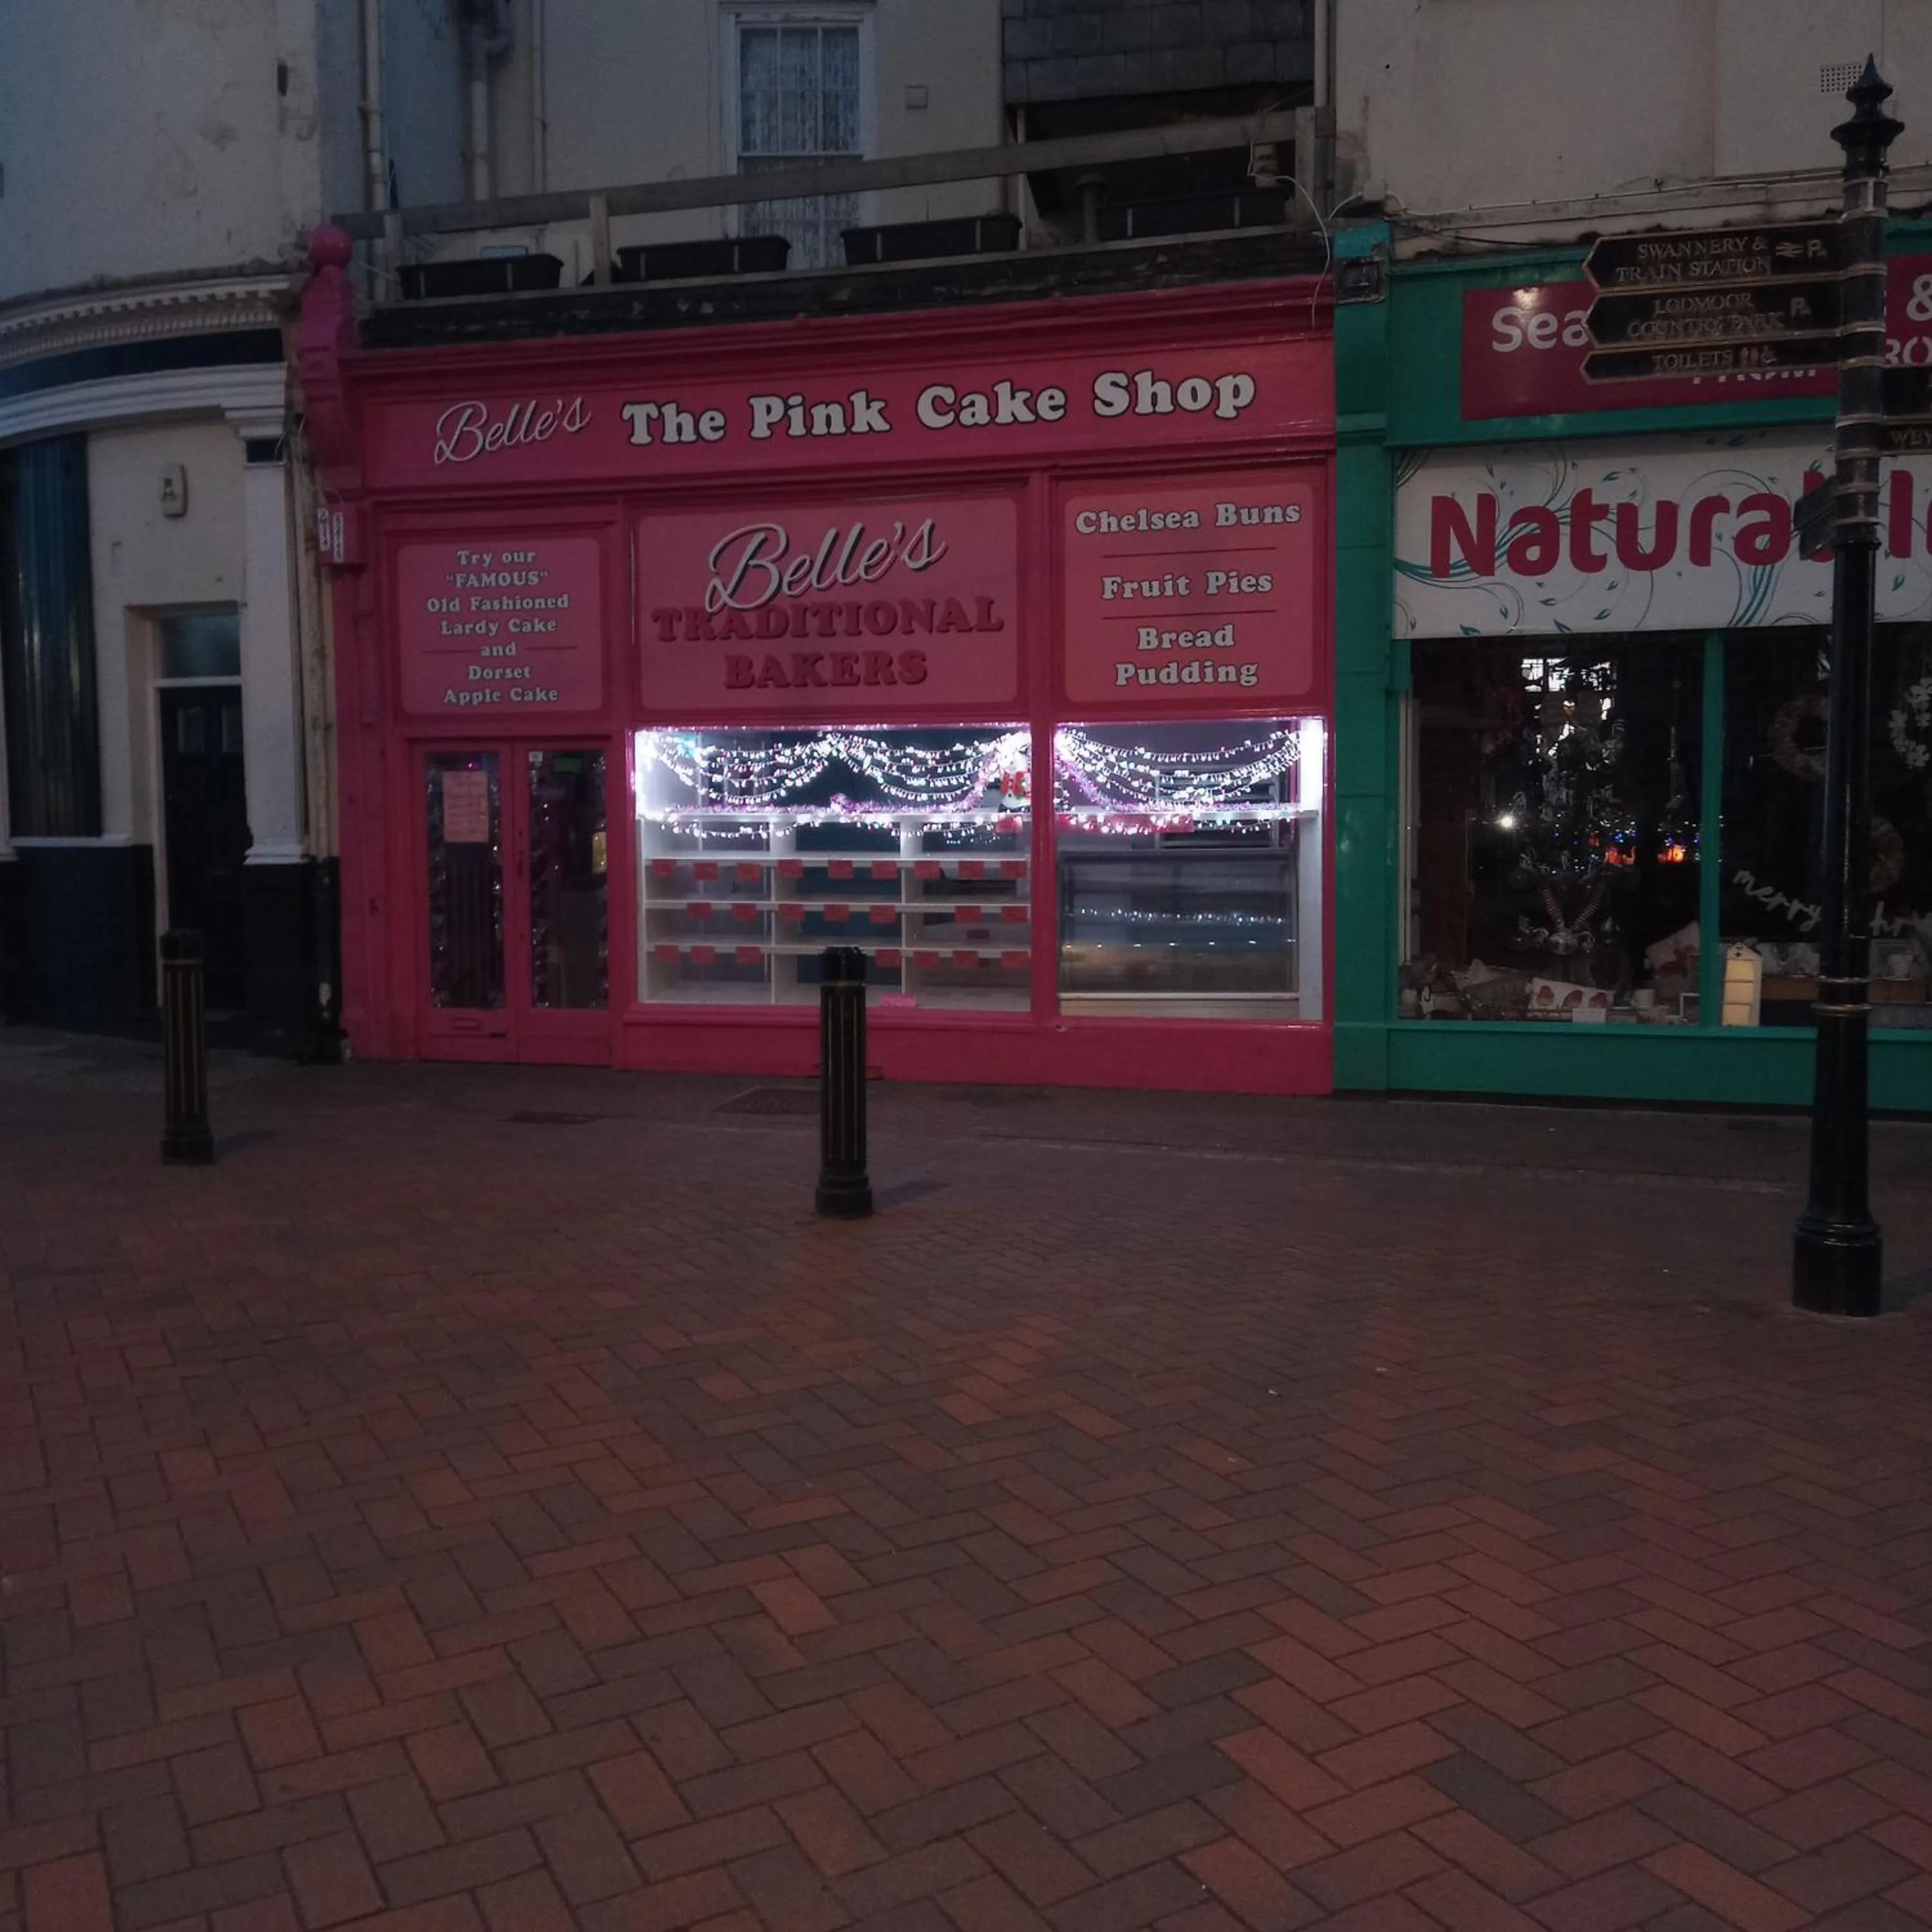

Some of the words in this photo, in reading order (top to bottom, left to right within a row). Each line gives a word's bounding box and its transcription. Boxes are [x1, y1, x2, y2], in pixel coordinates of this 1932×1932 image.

[1637, 236, 1748, 260] SWANNERY
[1751, 235, 1769, 251] &
[1615, 263, 1682, 283] TRAIN
[1688, 256, 1772, 277] STATION
[1654, 292, 1754, 314] LODMOOR
[1627, 316, 1724, 338] COUNTRY
[1728, 310, 1785, 329] PARK
[1652, 349, 1735, 370] TOILETS
[433, 395, 591, 464] Belle's
[620, 401, 727, 445] The
[748, 390, 893, 439] Pink
[916, 380, 1068, 430] Cake
[1093, 370, 1256, 419] Shop
[1075, 508, 1200, 535] Chelsea
[1215, 502, 1302, 527] Buns
[457, 549, 492, 567] Try
[502, 551, 536, 564] our
[704, 518, 949, 614] Belle's
[1101, 573, 1191, 600] Fruit
[1205, 570, 1274, 595] Pies
[426, 596, 461, 612] Old
[470, 593, 569, 611] Fashioned
[440, 620, 499, 636] Lardy
[507, 618, 557, 633] Cake
[650, 596, 1005, 643] TRADITIONAL
[480, 641, 517, 657] and
[1137, 623, 1236, 650] Bread
[468, 665, 532, 680] Dorset
[724, 649, 929, 690] BAKERS
[1114, 660, 1259, 687] Pudding
[443, 688, 501, 706] Apple
[509, 687, 558, 702] Cake
